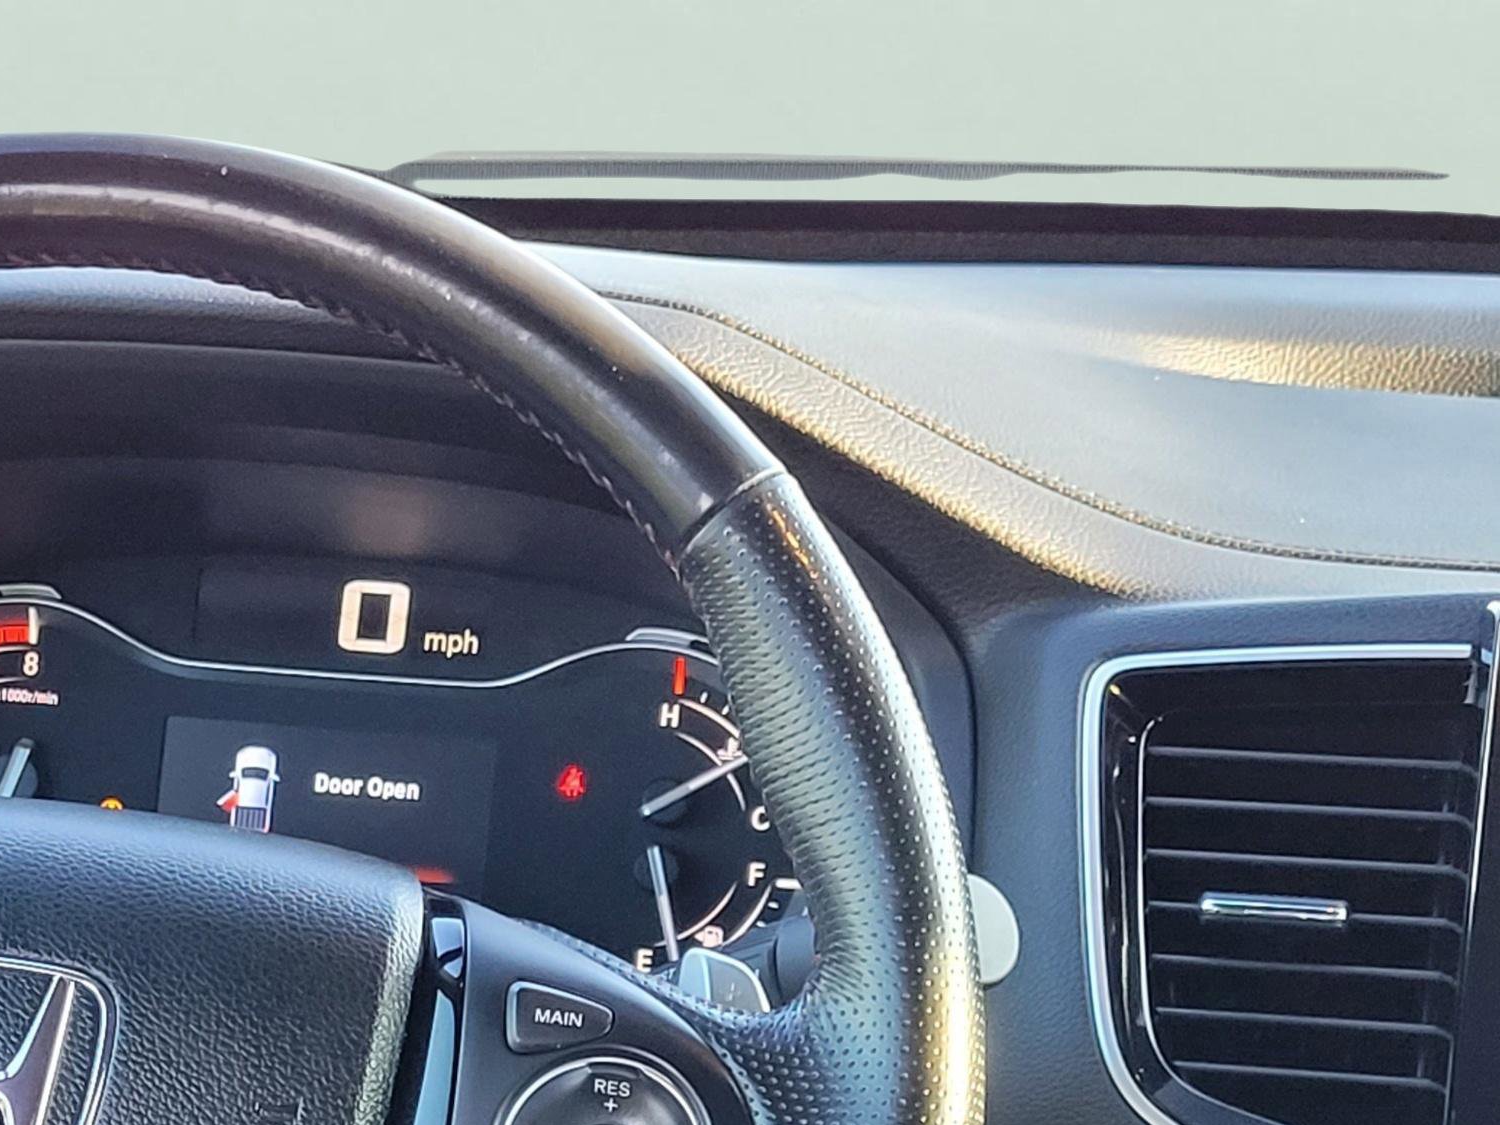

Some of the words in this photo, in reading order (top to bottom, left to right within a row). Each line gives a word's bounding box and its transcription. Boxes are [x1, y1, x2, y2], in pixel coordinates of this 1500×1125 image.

[338, 579, 411, 654] 0
[423, 628, 480, 659] mph
[23, 652, 39, 676] 8
[659, 703, 681, 728] H
[314, 772, 363, 796] Door
[367, 776, 420, 801] Open
[751, 805, 771, 832] C
[748, 862, 766, 887] F
[636, 948, 654, 973] E
[534, 1008, 583, 1028] MAIN
[593, 1078, 631, 1098] RES
